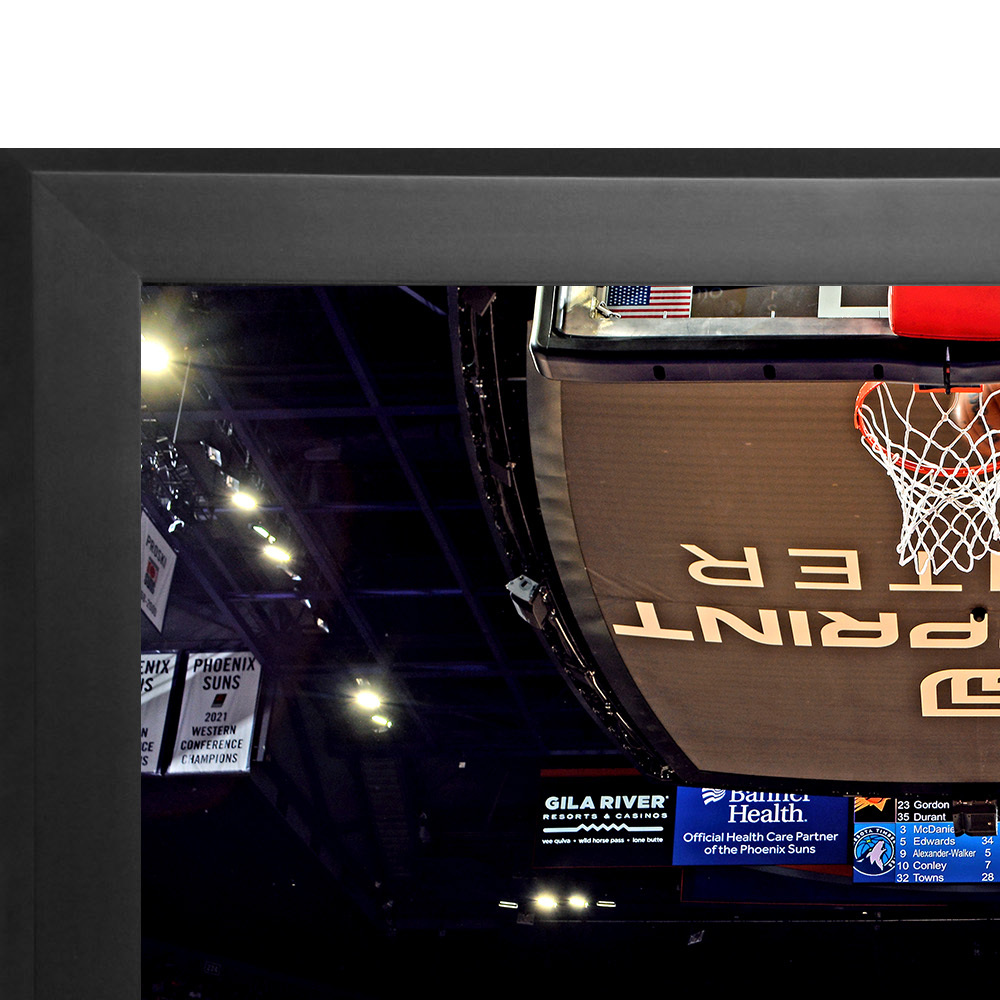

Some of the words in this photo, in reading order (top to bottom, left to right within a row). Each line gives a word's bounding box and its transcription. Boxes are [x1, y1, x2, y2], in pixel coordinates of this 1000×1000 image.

[193, 657, 256, 673] PHOENIX
[203, 675, 241, 690] SUNS
[204, 712, 227, 722] 2021
[192, 725, 236, 736] WESTERN
[180, 739, 243, 751] CONFERENCE
[544, 796, 595, 810] GILA
[600, 795, 666, 810] RIVER
[897, 801, 910, 809] 23
[913, 801, 950, 809] Gordon
[897, 813, 910, 821] 35
[913, 812, 946, 821] Durant
[899, 825, 907, 834] 3
[683, 831, 724, 842] Official
[726, 831, 764, 842] Health
[766, 831, 794, 842] Care
[795, 831, 839, 842] Partner
[899, 837, 907, 846] 5
[913, 837, 956, 846] Edwards
[981, 837, 994, 845] 34
[704, 844, 717, 855] of
[718, 844, 738, 855] the
[740, 844, 786, 855] Phoenix
[787, 843, 816, 854] Suns
[899, 850, 907, 858] 9
[912, 849, 976, 858] Alexander-Walker
[984, 848, 992, 857] 5
[897, 861, 910, 870] 10
[912, 861, 947, 872] Conley
[985, 861, 992, 869] 7
[896, 874, 909, 883] 32
[912, 873, 945, 882] Towns
[981, 873, 995, 882] 28
